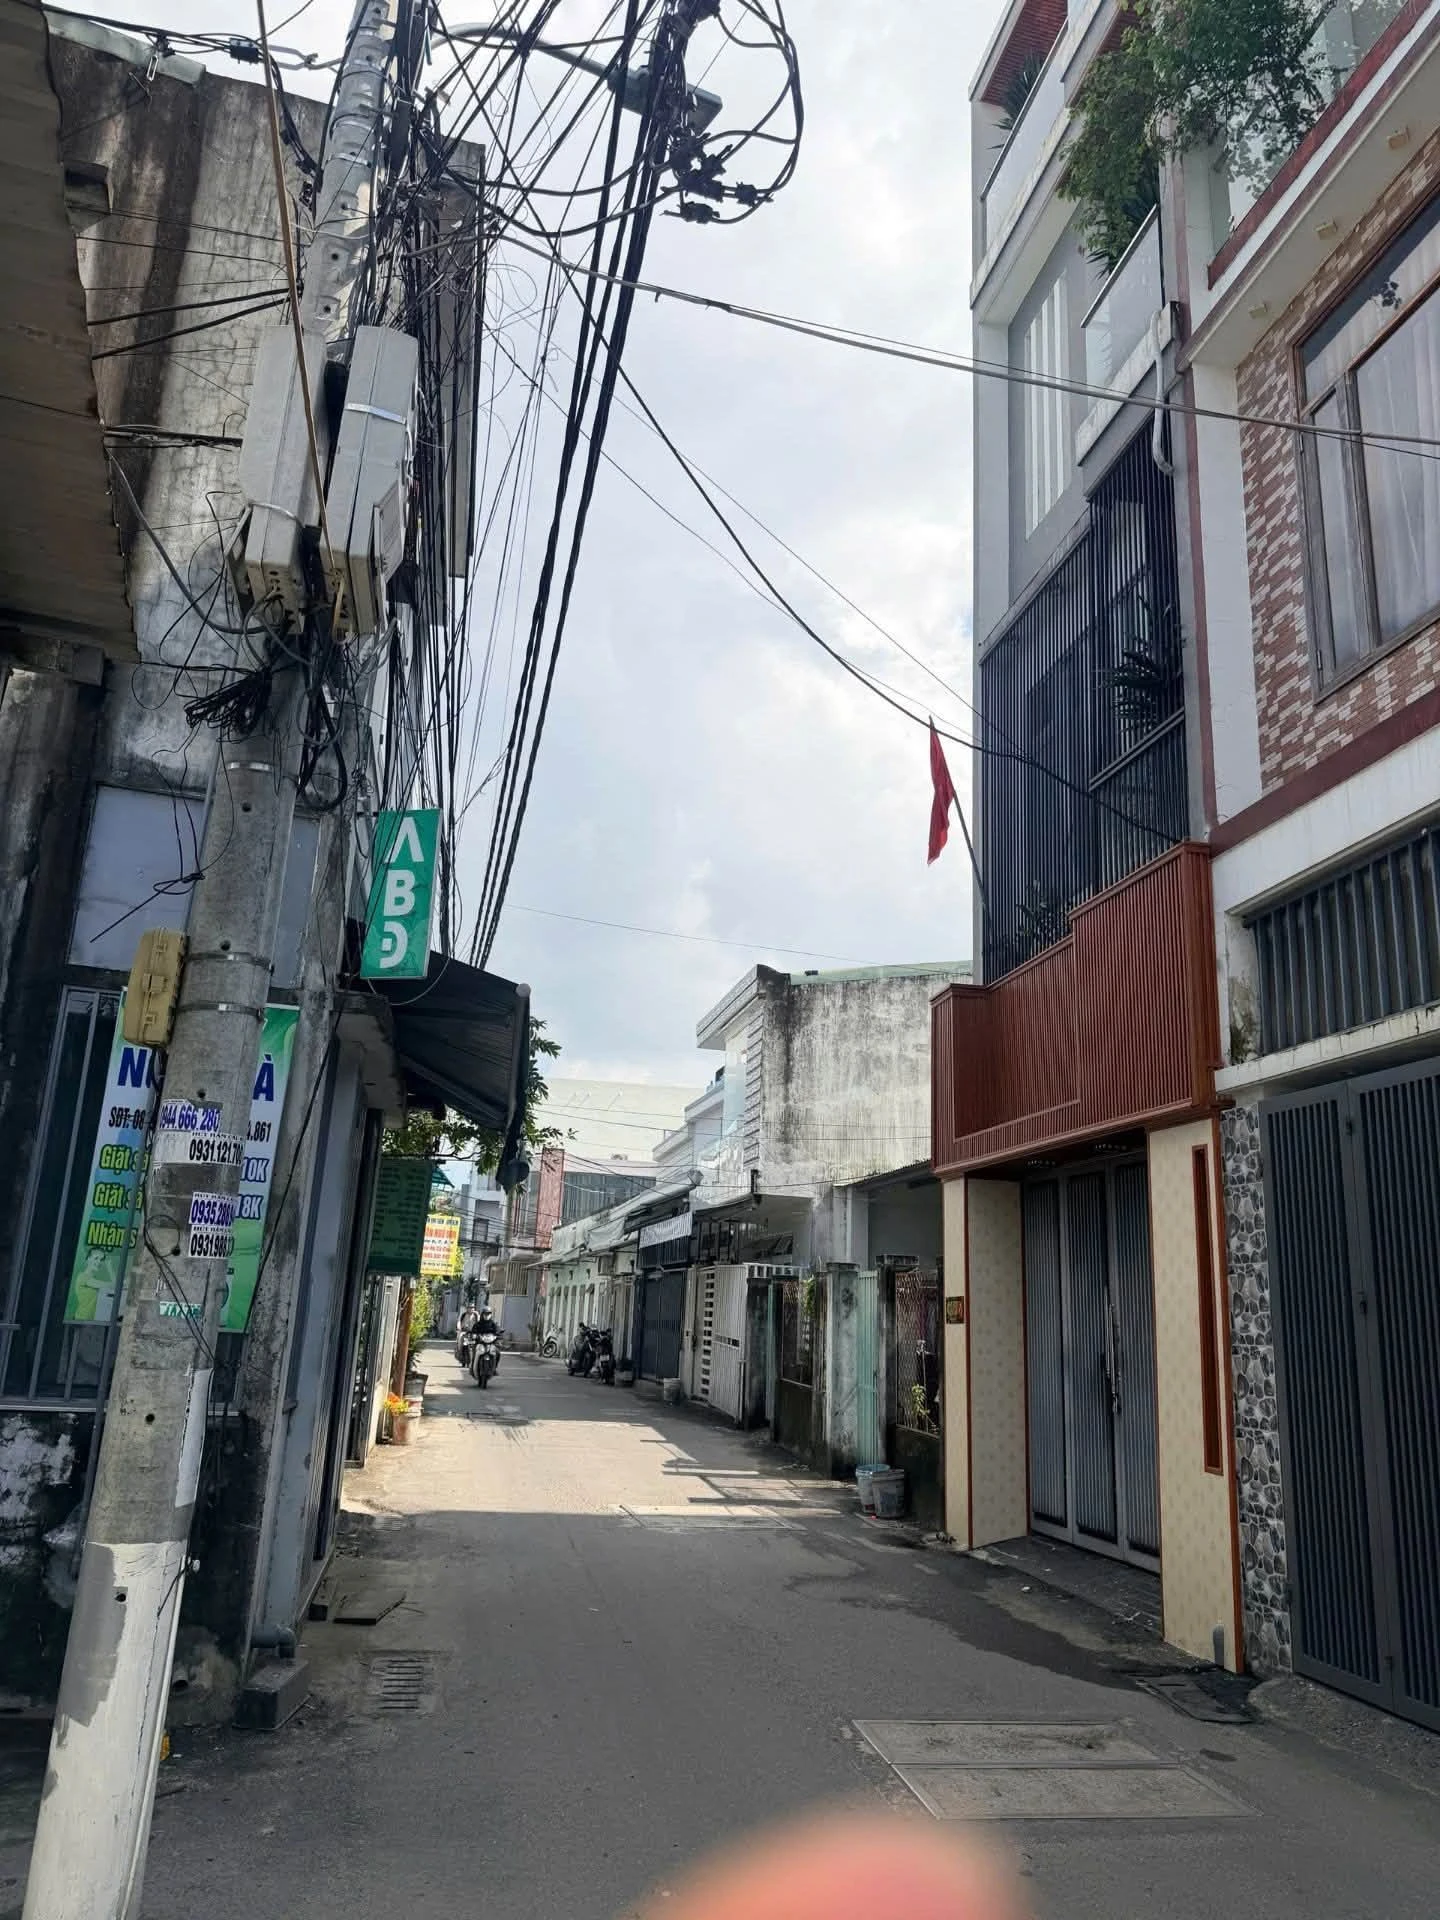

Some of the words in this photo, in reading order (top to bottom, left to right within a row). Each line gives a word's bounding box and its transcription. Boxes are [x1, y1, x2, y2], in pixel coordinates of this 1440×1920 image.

[100, 1144, 132, 1175] Giặt
[242, 1157, 269, 1182] 10K
[93, 1183, 124, 1213] Giặt
[235, 1195, 263, 1219] 18K
